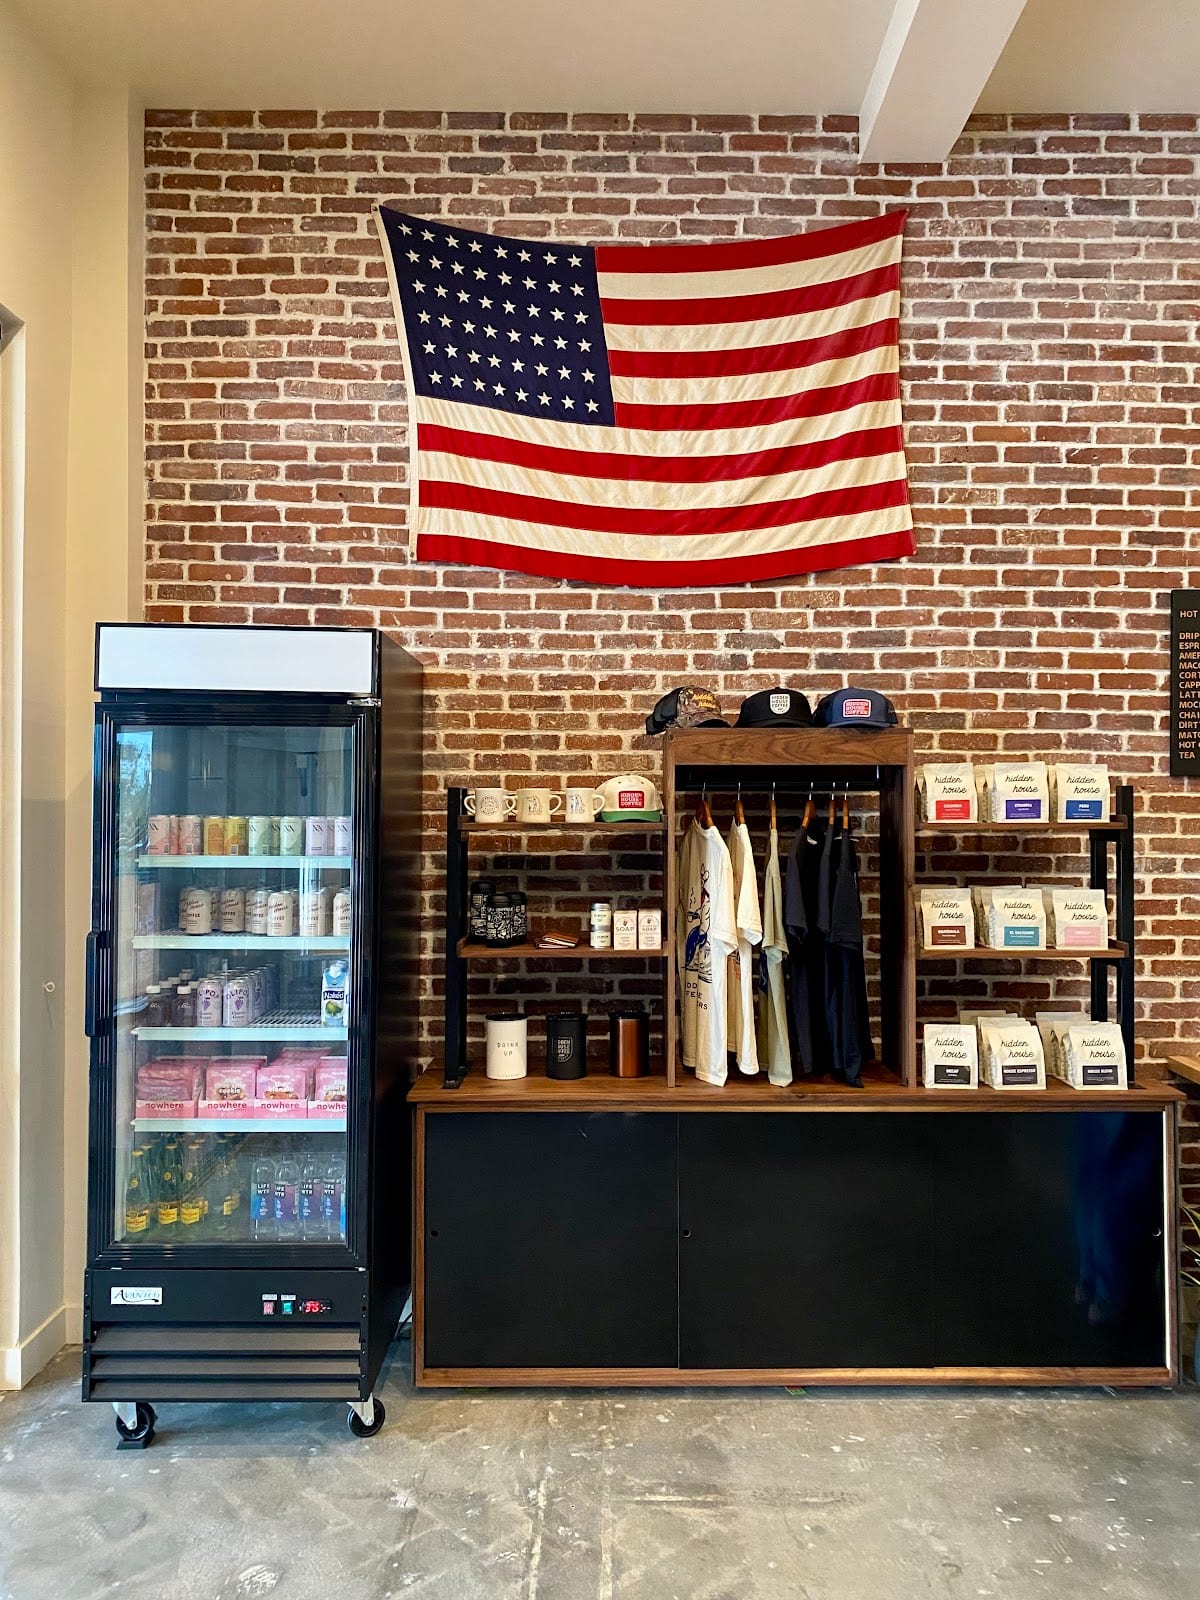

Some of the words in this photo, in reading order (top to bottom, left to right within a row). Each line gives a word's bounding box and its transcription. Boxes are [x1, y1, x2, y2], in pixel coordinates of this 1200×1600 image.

[934, 775, 963, 783] hidden
[1004, 774, 1035, 783] hidden
[1066, 775, 1096, 783] hidden
[942, 785, 968, 794] house
[1012, 784, 1039, 793] house
[1074, 785, 1101, 793] house
[1004, 901, 1033, 909] hidden
[1064, 902, 1094, 910] hidden
[1011, 912, 1037, 920] house
[934, 1037, 964, 1046] hidden
[1001, 1039, 1029, 1047] hidden
[1082, 1038, 1111, 1046] hidden
[940, 1049, 968, 1058] house
[1008, 1049, 1035, 1058] house
[1089, 1050, 1116, 1058] house
[317, 1102, 347, 1110] nowhe
